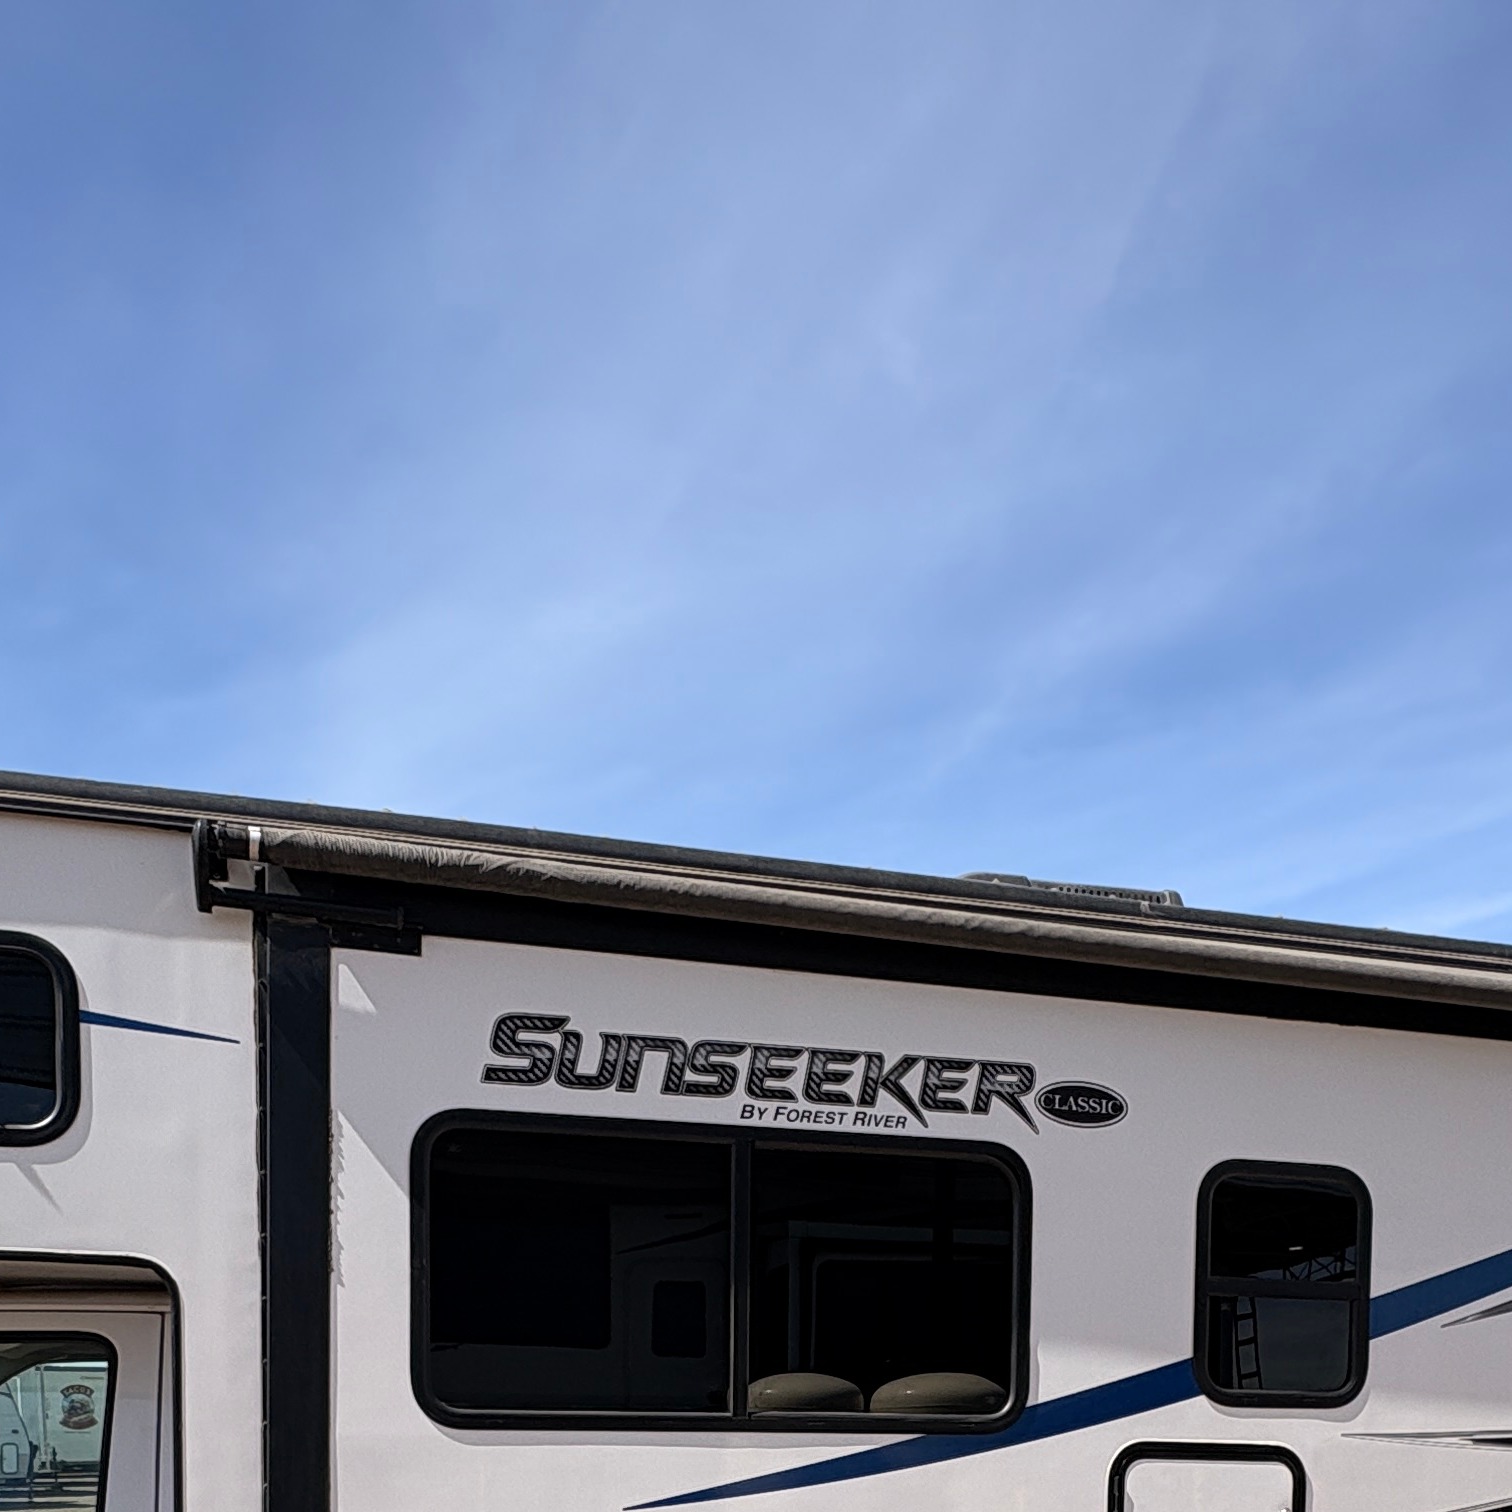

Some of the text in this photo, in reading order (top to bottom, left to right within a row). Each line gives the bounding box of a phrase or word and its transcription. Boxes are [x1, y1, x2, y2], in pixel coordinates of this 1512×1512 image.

[481, 1012, 1039, 1135] SUNSEEKER
[740, 1104, 908, 1129] BY FOREST RIVER
[1040, 1093, 1121, 1115] CLASSIC
